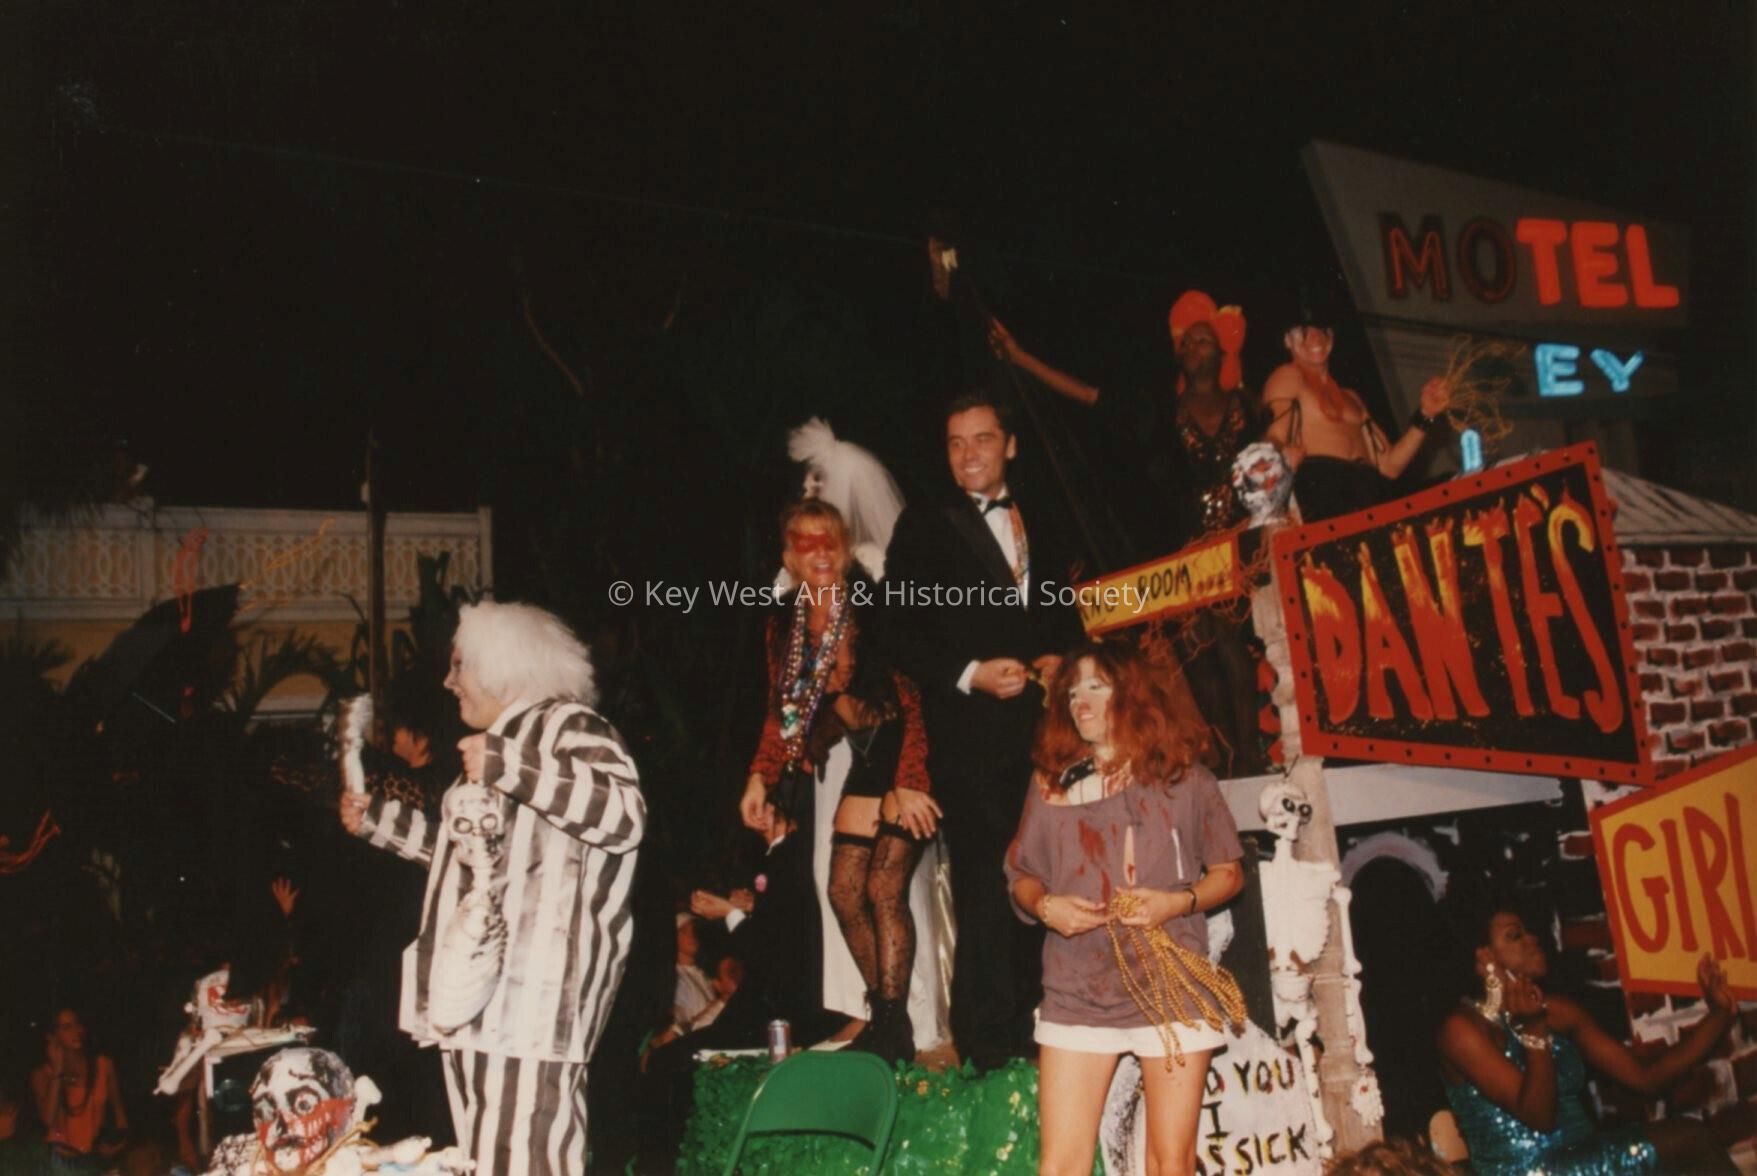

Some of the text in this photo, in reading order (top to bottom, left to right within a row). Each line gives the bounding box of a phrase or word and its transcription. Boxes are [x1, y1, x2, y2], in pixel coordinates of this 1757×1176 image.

[1377, 210, 1680, 309] MOTEL
[1302, 482, 1624, 734] DANTE'S
[1232, 1058, 1295, 1095] YOU
[1234, 1122, 1311, 1175] SICK
